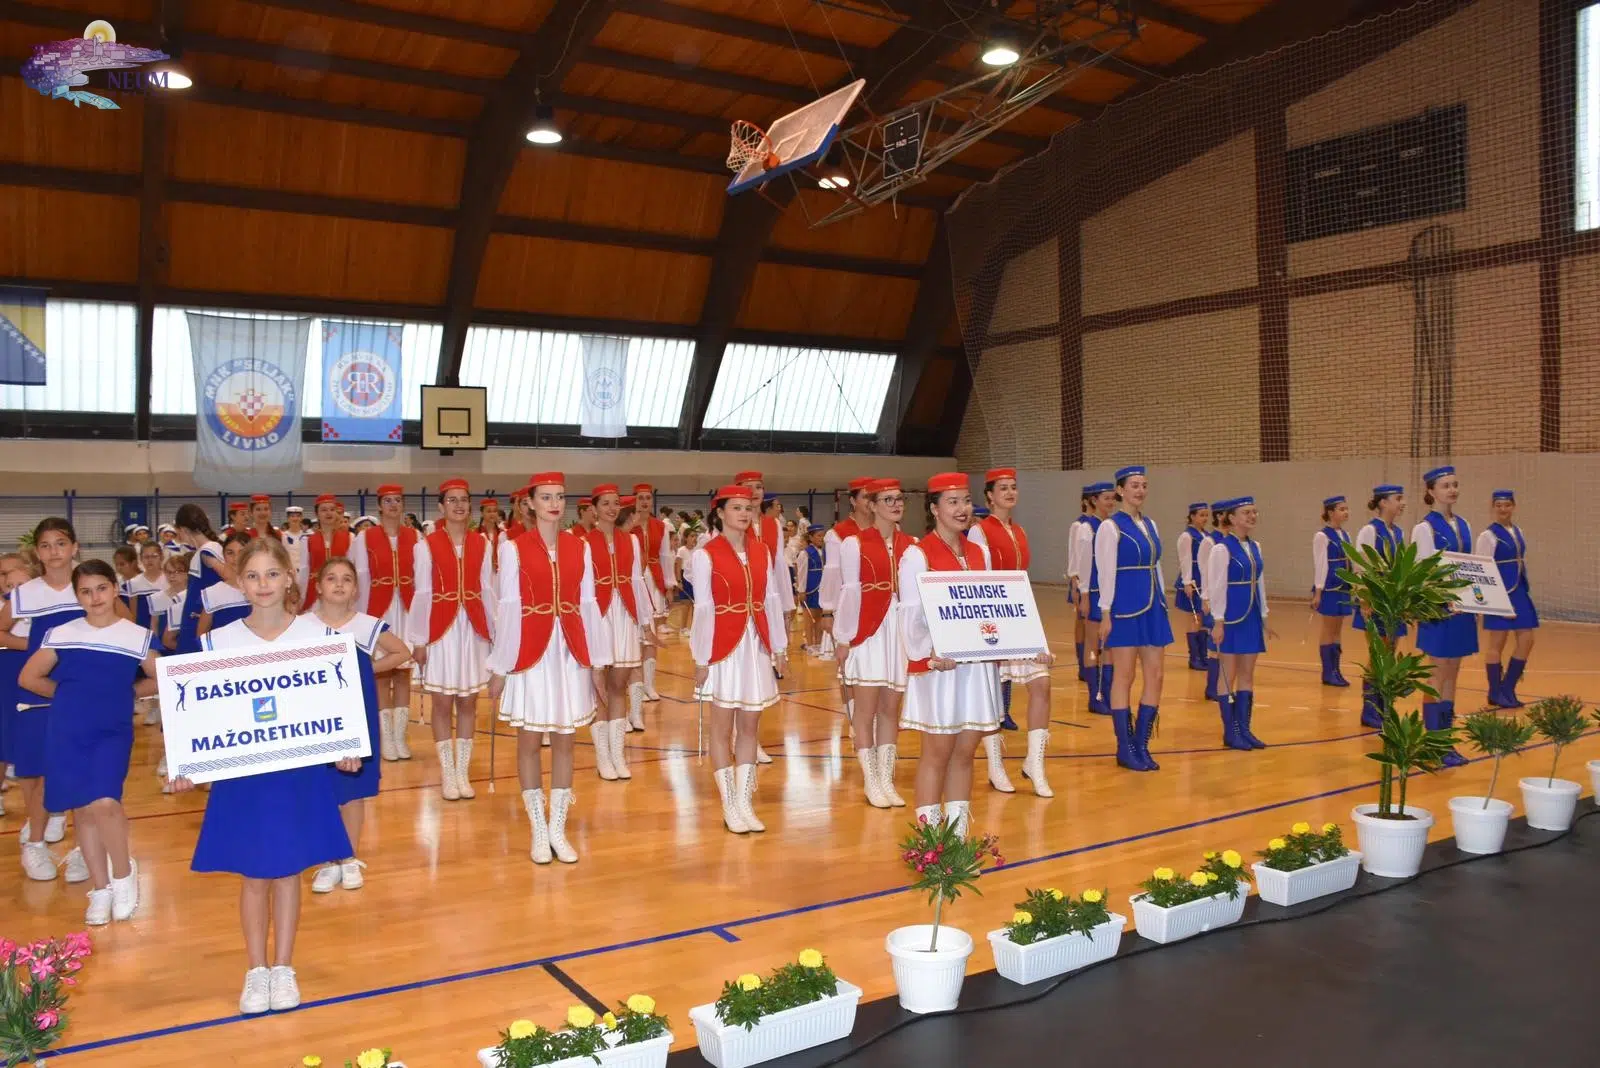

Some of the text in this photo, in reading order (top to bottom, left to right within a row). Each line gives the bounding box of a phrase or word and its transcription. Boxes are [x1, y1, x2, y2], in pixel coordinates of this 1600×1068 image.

[222, 430, 279, 449] LIVNO
[948, 584, 1008, 600] NEUMSKE
[938, 602, 1027, 621] MAŽORETKINJE
[195, 669, 328, 701] BAŠKOVOŠKE
[191, 716, 344, 753] MAŽORETKINJE
